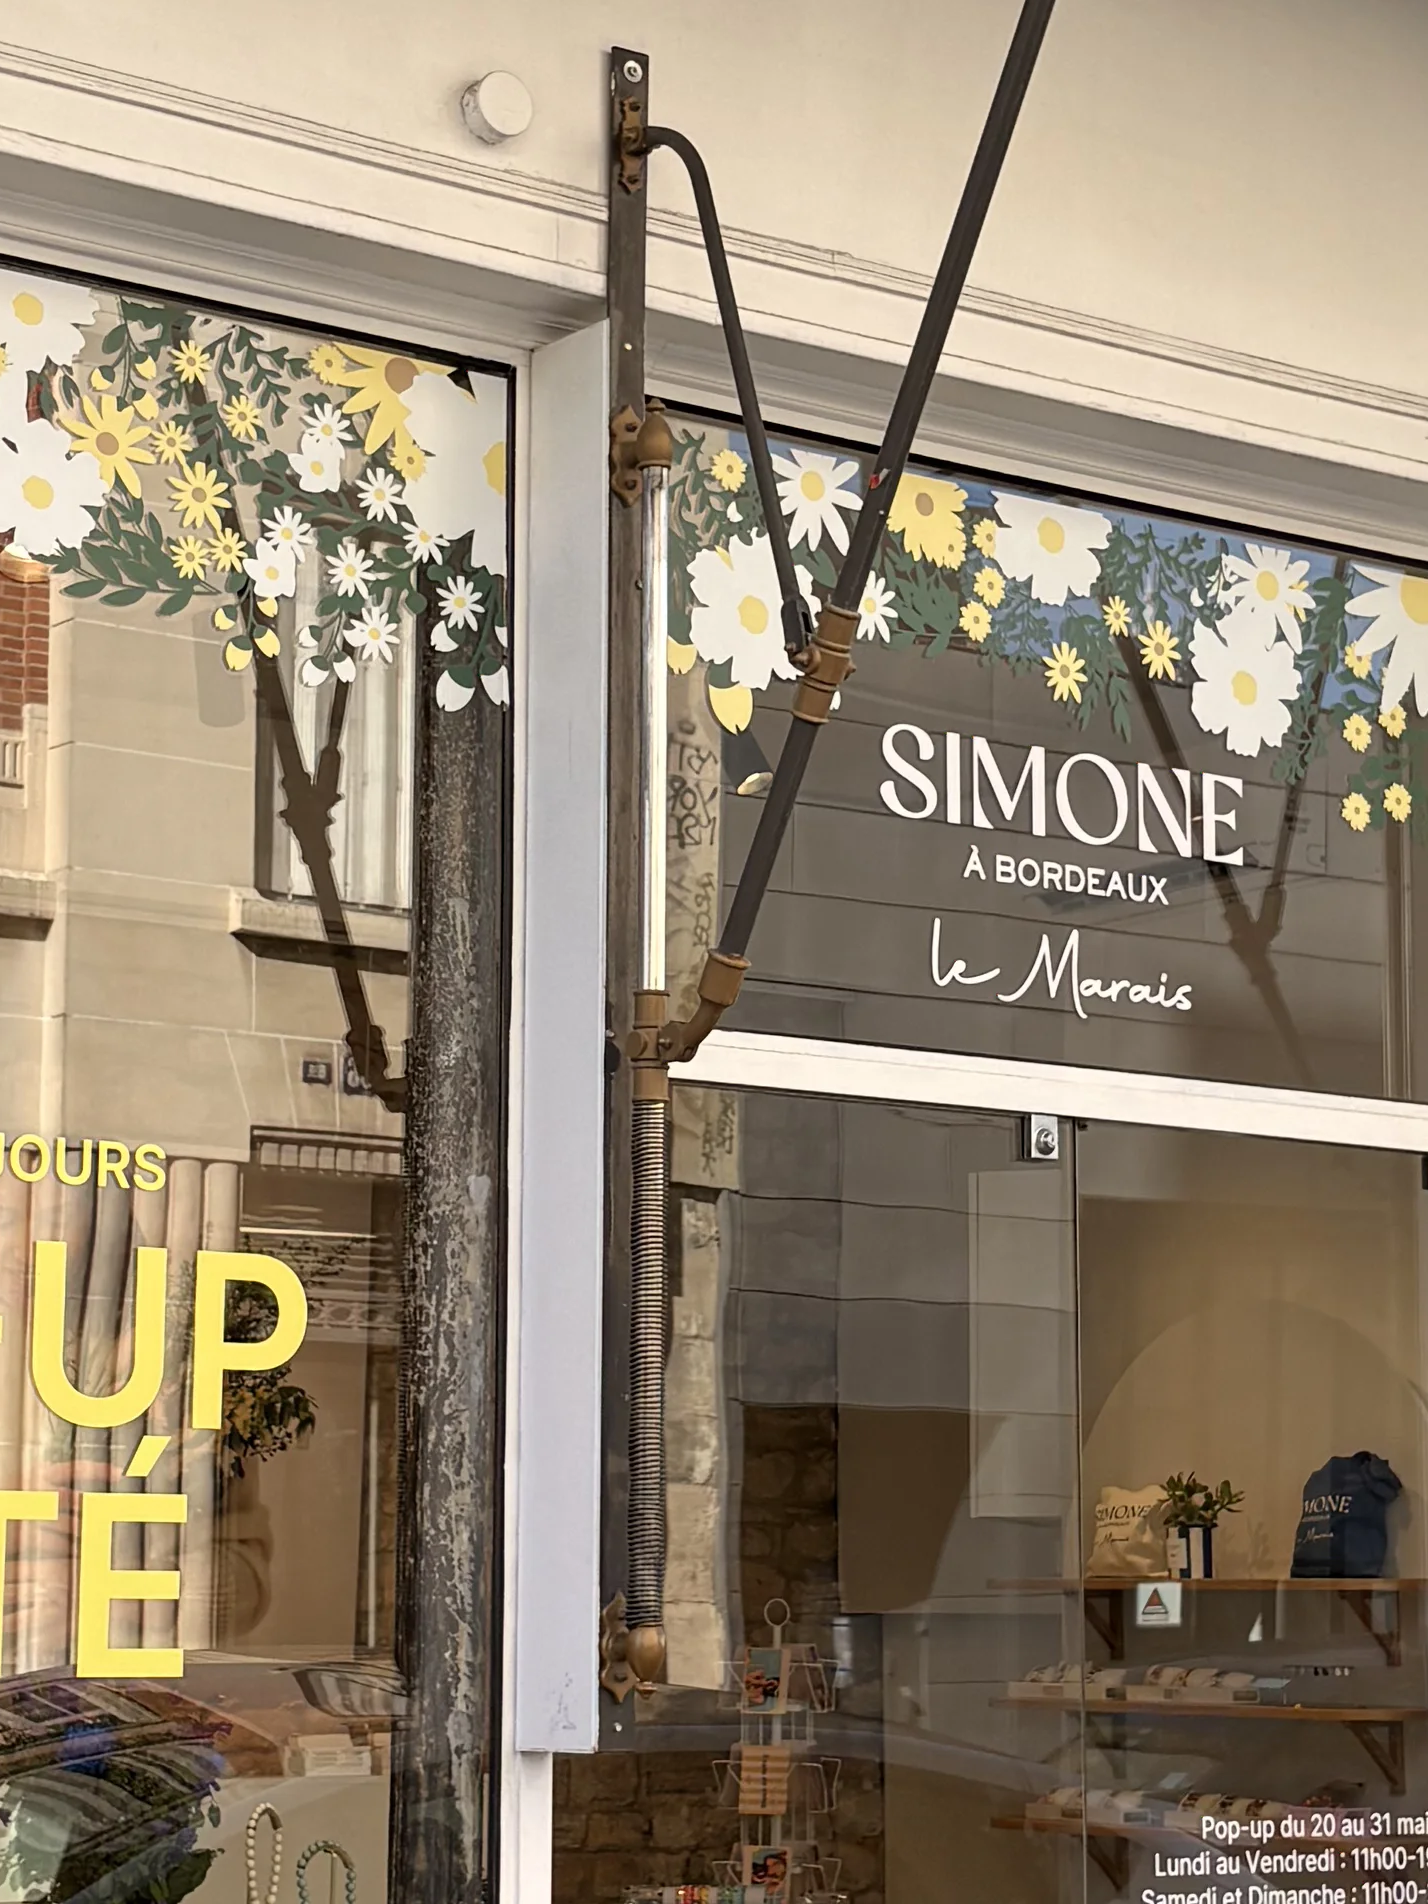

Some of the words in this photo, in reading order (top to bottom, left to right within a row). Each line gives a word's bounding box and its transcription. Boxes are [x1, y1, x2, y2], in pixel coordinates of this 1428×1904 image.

[879, 723, 1244, 866] SIMONE
[963, 844, 986, 880] À
[995, 854, 1169, 906] BORDEAUX
[930, 918, 1000, 986] le
[997, 929, 1192, 1019] Marais
[1201, 1815, 1275, 1844] Pop-up
[1280, 1814, 1306, 1838] du
[1311, 1813, 1336, 1837] 20
[1341, 1818, 1365, 1837] au
[1370, 1812, 1392, 1836] 31
[1154, 1851, 1211, 1877] Lundi
[1216, 1855, 1240, 1875] au
[1245, 1848, 1336, 1874] Vendredi
